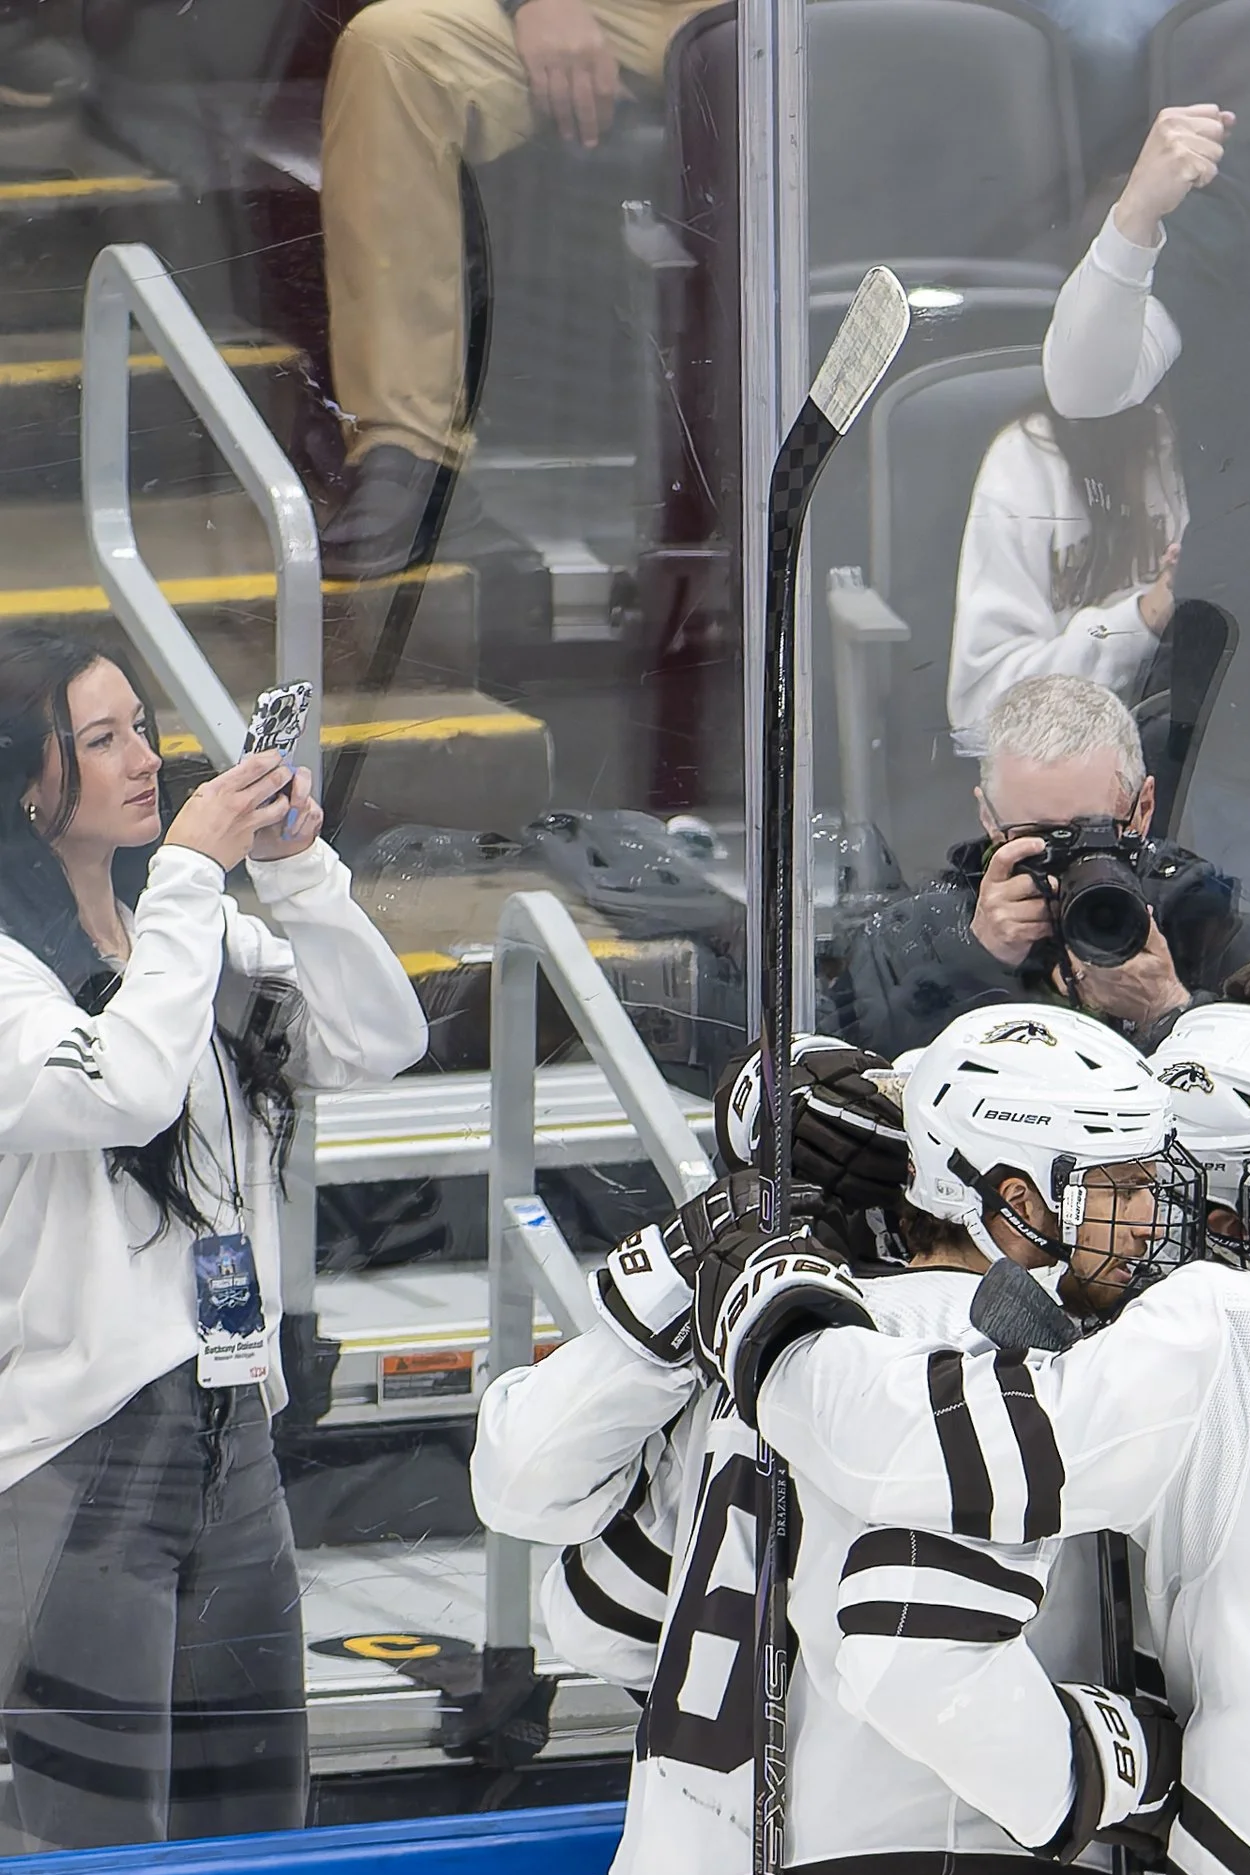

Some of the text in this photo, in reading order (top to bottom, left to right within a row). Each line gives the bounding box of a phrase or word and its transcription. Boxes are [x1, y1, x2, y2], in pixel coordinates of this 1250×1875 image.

[983, 1109, 1052, 1126] BAUER
[1000, 1207, 1049, 1247] BAUER
[776, 1479, 787, 1537] DRAZNER
